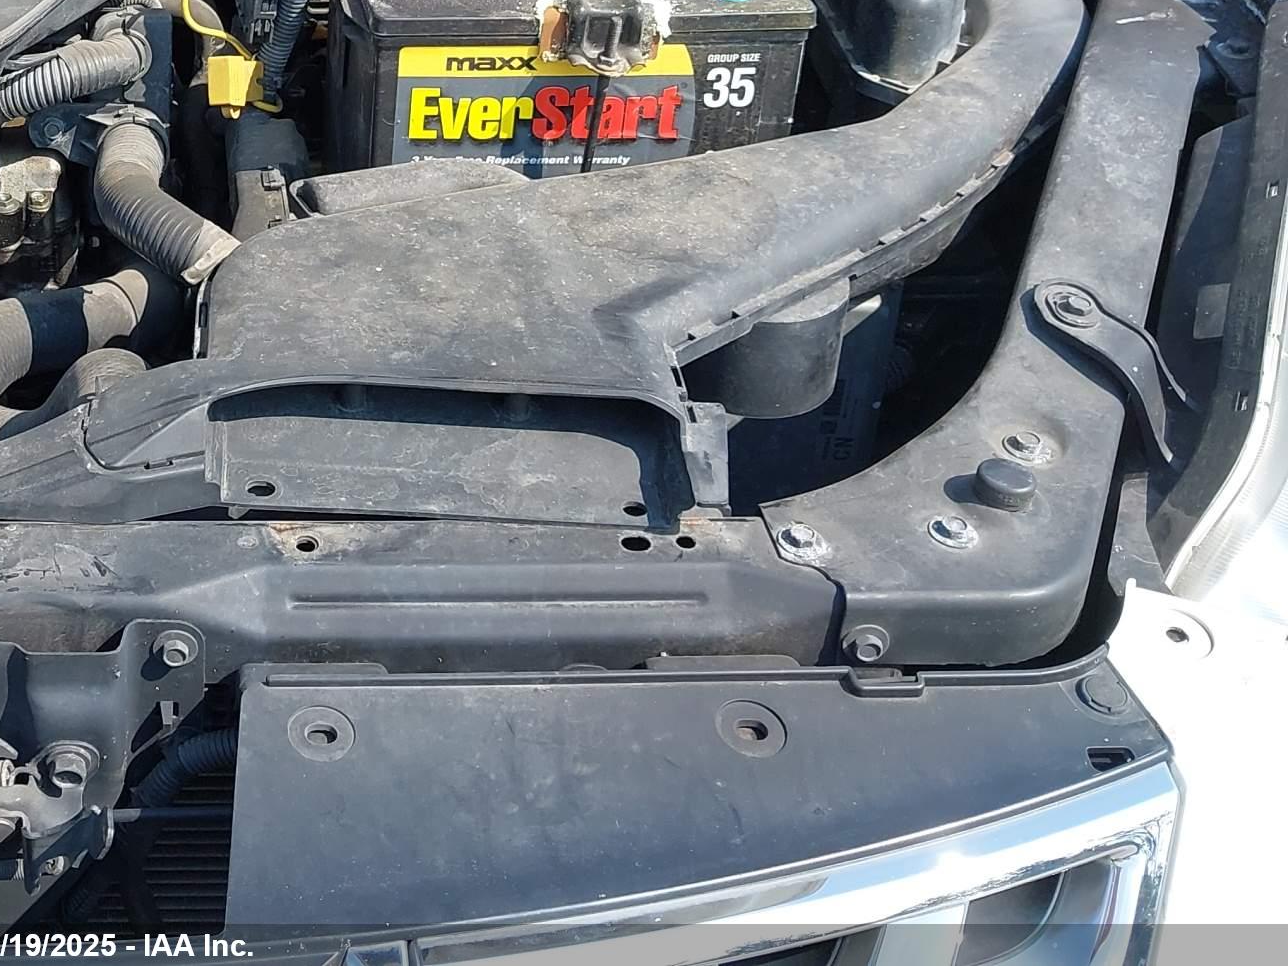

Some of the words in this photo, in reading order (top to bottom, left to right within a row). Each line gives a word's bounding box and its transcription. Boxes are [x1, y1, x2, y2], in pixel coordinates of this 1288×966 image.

[445, 56, 539, 72] maxx
[707, 53, 737, 64] GROUP
[738, 53, 761, 63] SIZE
[703, 67, 757, 109] 35
[407, 85, 684, 142] EverStart
[486, 155, 570, 166] Replacement
